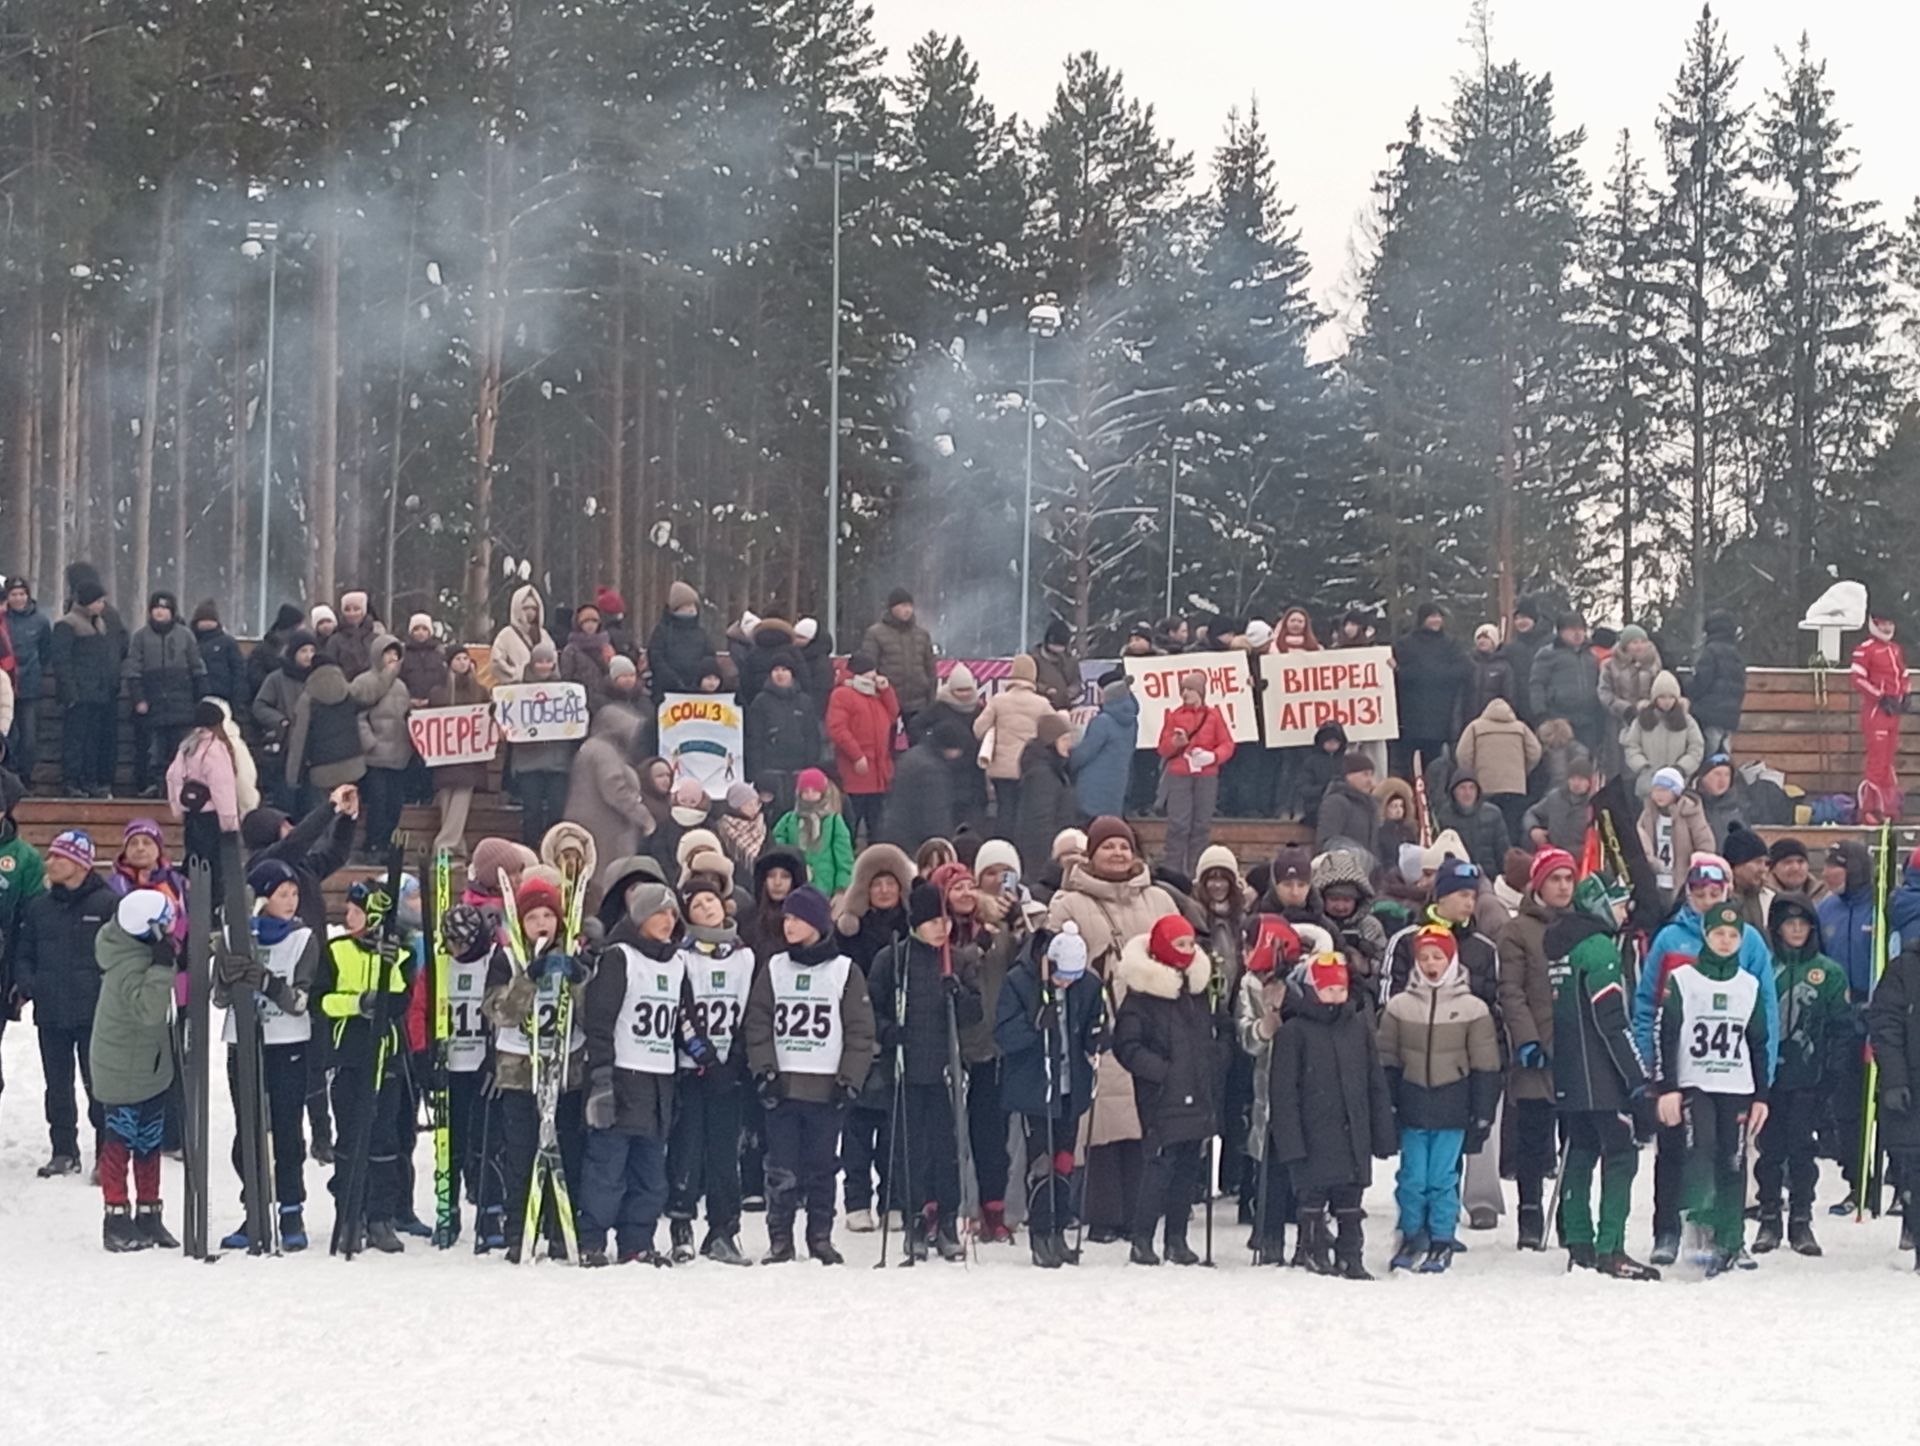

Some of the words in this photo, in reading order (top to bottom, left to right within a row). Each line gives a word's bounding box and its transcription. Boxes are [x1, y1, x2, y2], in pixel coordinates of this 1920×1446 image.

[1283, 662, 1380, 693] ВПЕРЕД
[501, 700, 514, 726] К
[1280, 696, 1383, 731] АГРЫЗ!
[775, 1003, 832, 1039] 325
[1689, 1022, 1744, 1060] 347
